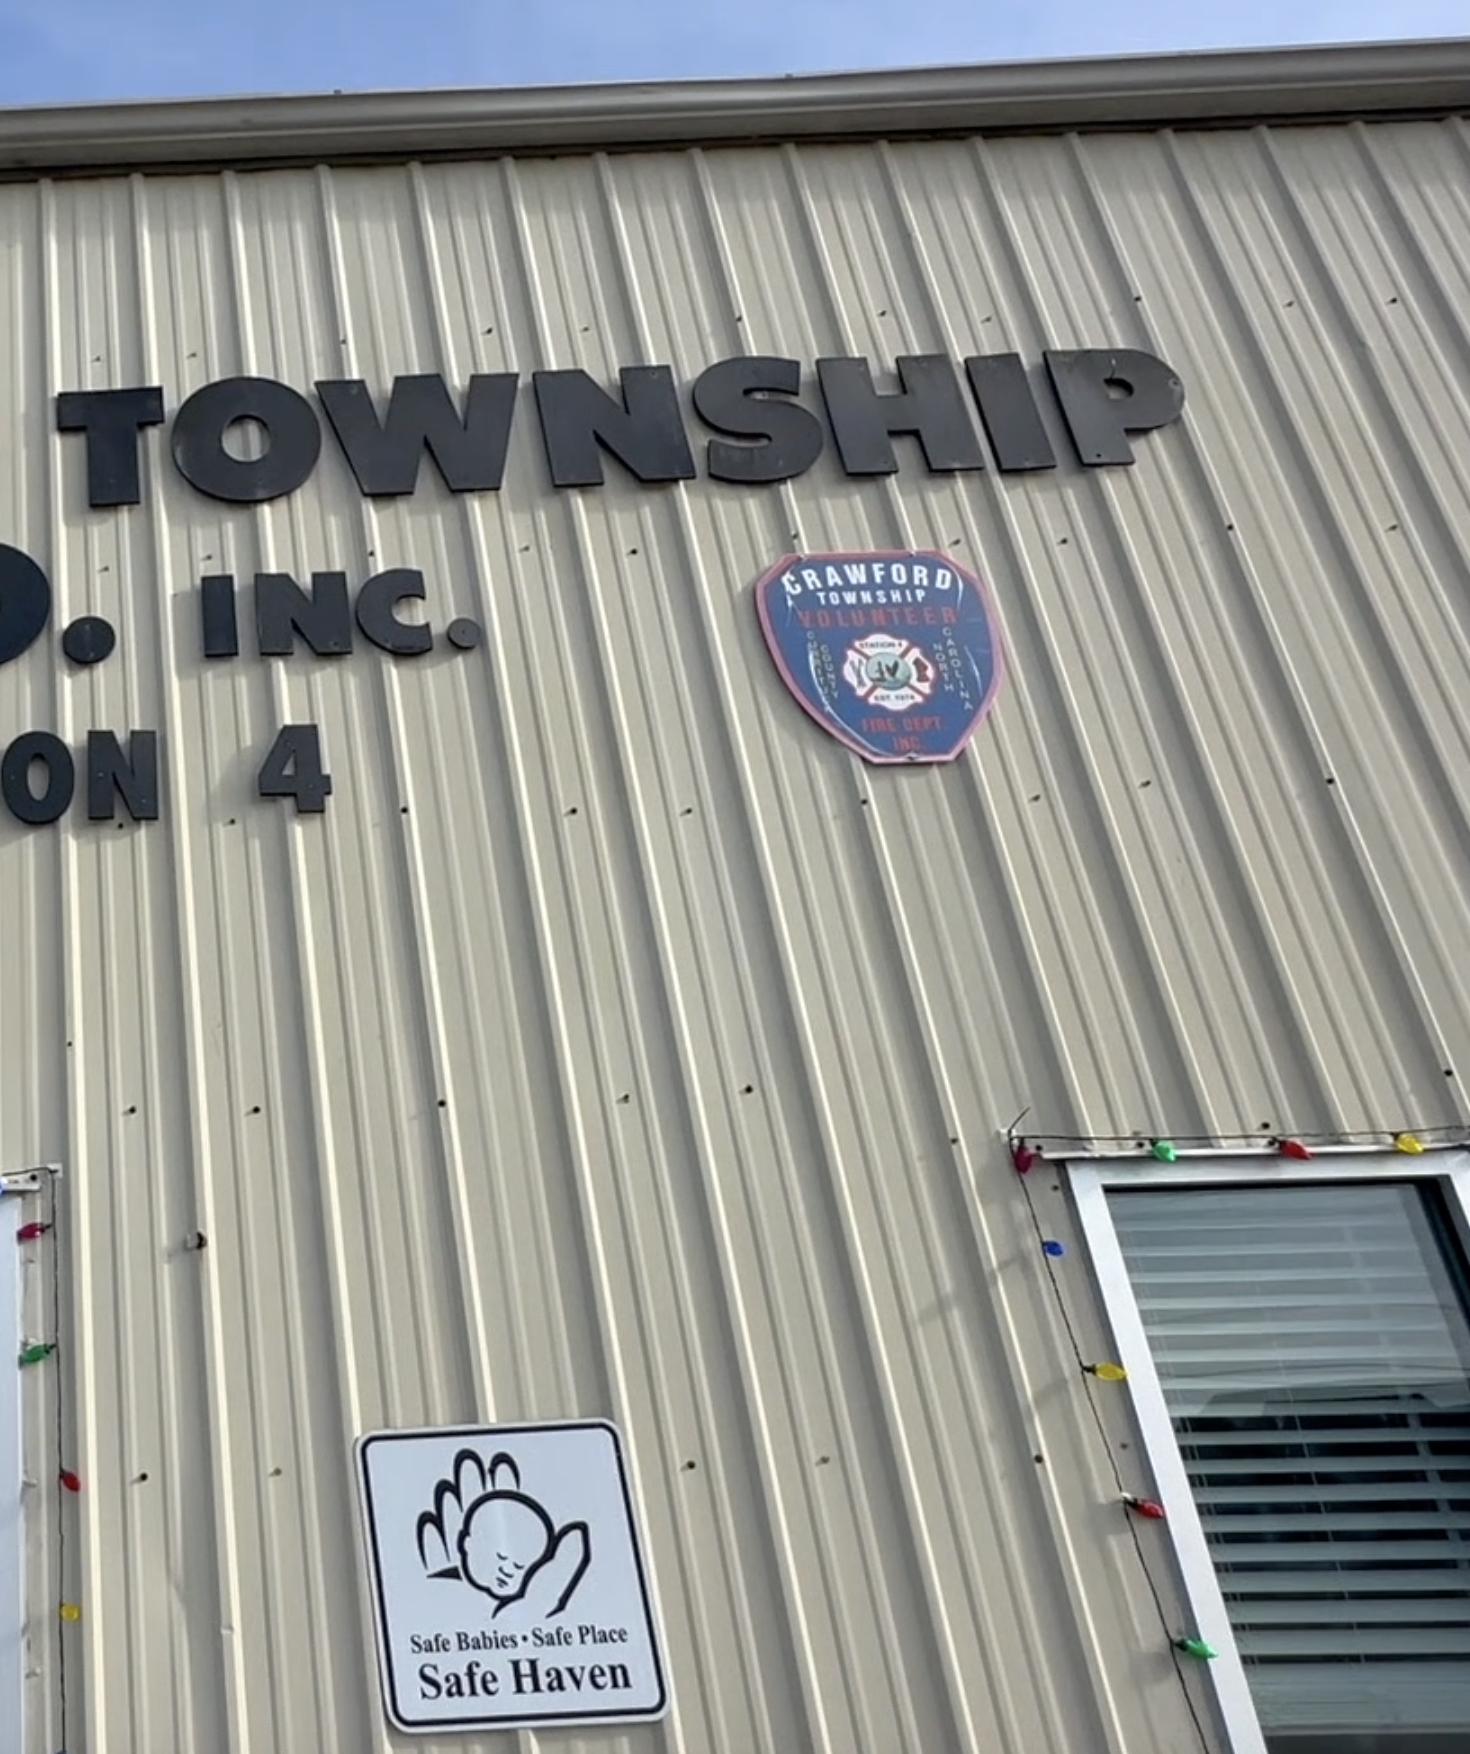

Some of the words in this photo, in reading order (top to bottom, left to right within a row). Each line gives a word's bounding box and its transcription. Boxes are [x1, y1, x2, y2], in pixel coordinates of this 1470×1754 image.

[57, 347, 1185, 508] TOWNSHIP
[781, 562, 953, 596] CRAWFORD
[817, 588, 926, 606] TOWNSHIP
[201, 568, 481, 657] INC.
[798, 606, 958, 629] VOLUNTEER
[820, 645, 839, 699] COUNTY
[933, 643, 955, 692] NORTH
[942, 626, 974, 710] CAROLINA
[862, 717, 897, 733] FIRE
[258, 724, 332, 813] 4
[410, 1633, 451, 1655] Safe
[455, 1630, 518, 1652] Babies
[532, 1626, 573, 1648] Safe
[579, 1624, 629, 1645] Place
[418, 1661, 499, 1700] Safe
[509, 1657, 632, 1695] Haven
